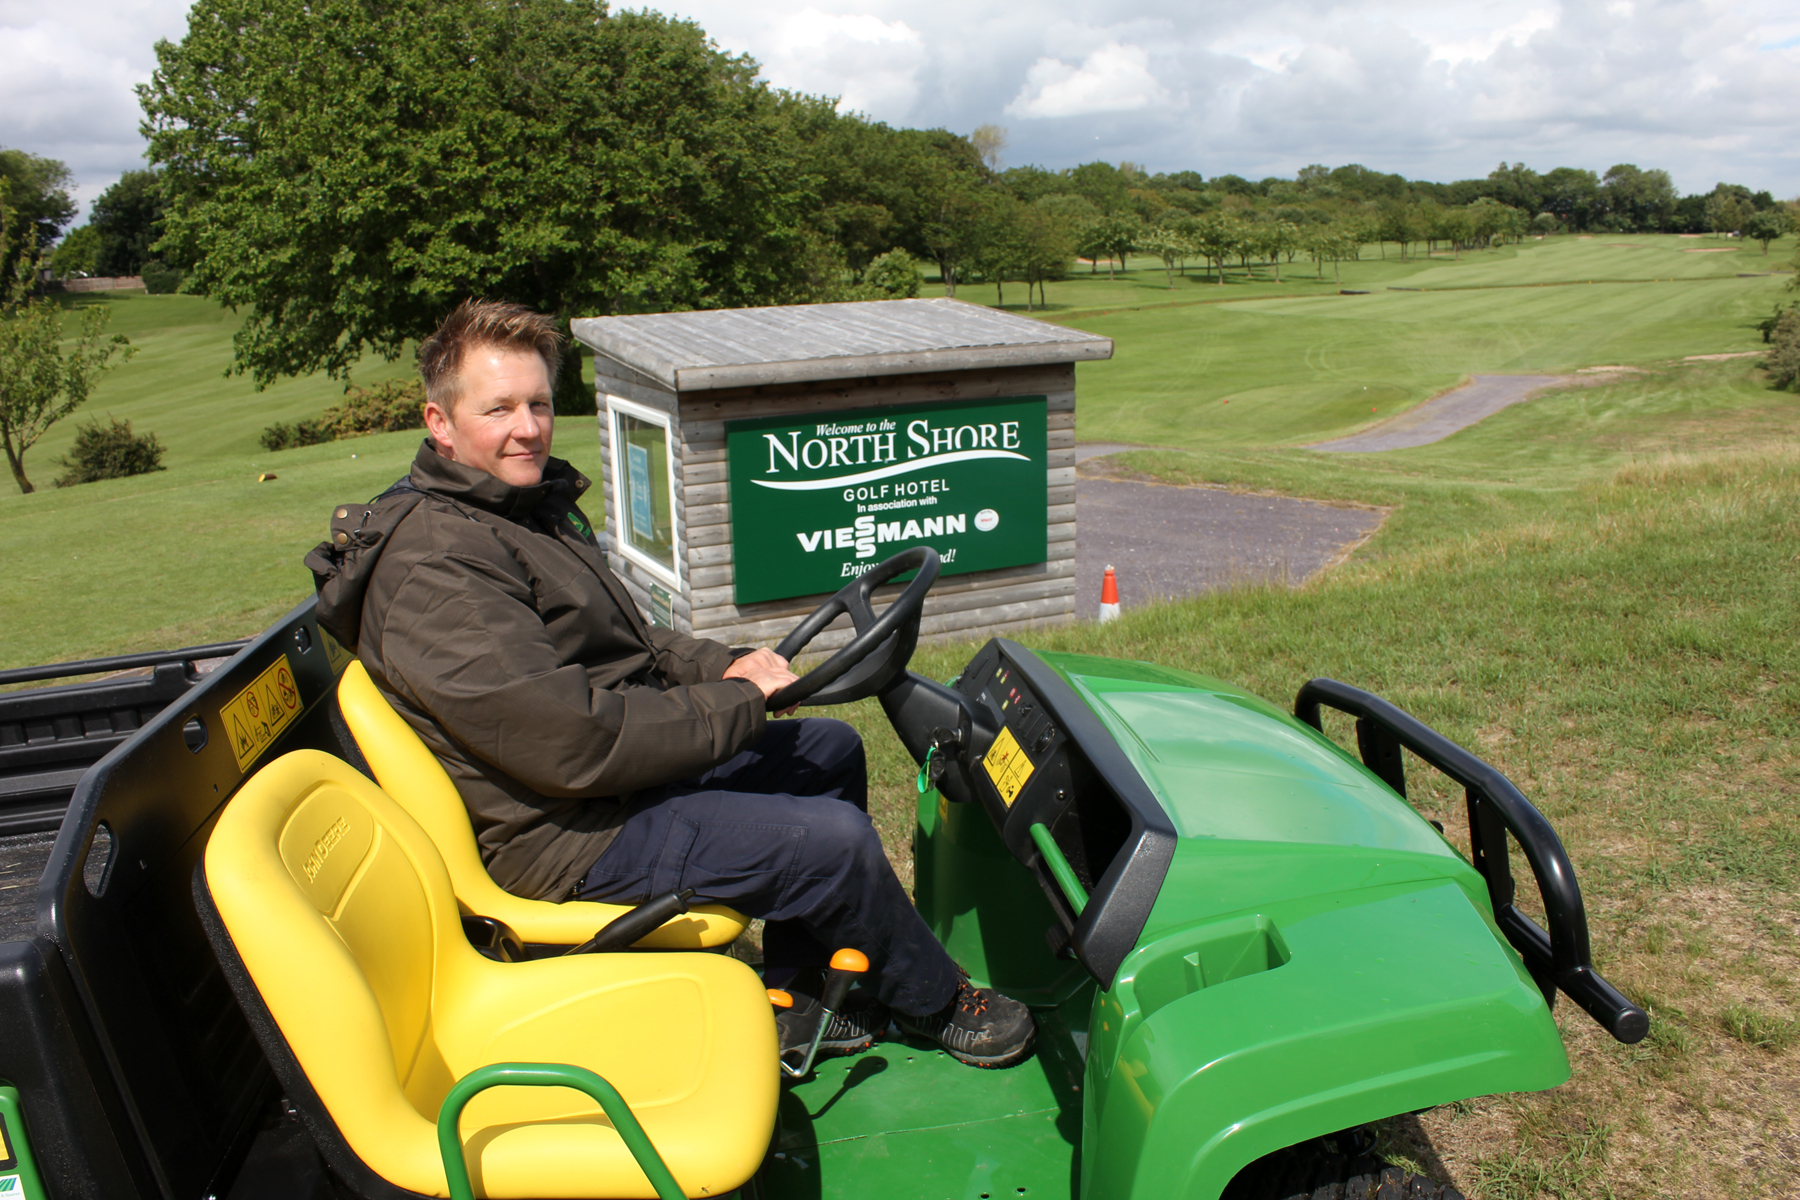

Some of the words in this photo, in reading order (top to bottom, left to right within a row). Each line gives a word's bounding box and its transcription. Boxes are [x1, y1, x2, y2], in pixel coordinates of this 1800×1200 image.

[816, 423, 863, 436] Welcome
[866, 422, 877, 432] to
[879, 419, 896, 431] the
[762, 431, 897, 473] NORTH
[907, 419, 1020, 458] SHORE
[843, 485, 889, 502] GOLF
[895, 479, 950, 496] HOTEL
[857, 503, 866, 513] In
[867, 498, 917, 512] association
[919, 495, 938, 506] with
[796, 513, 966, 558] VIESSMANN
